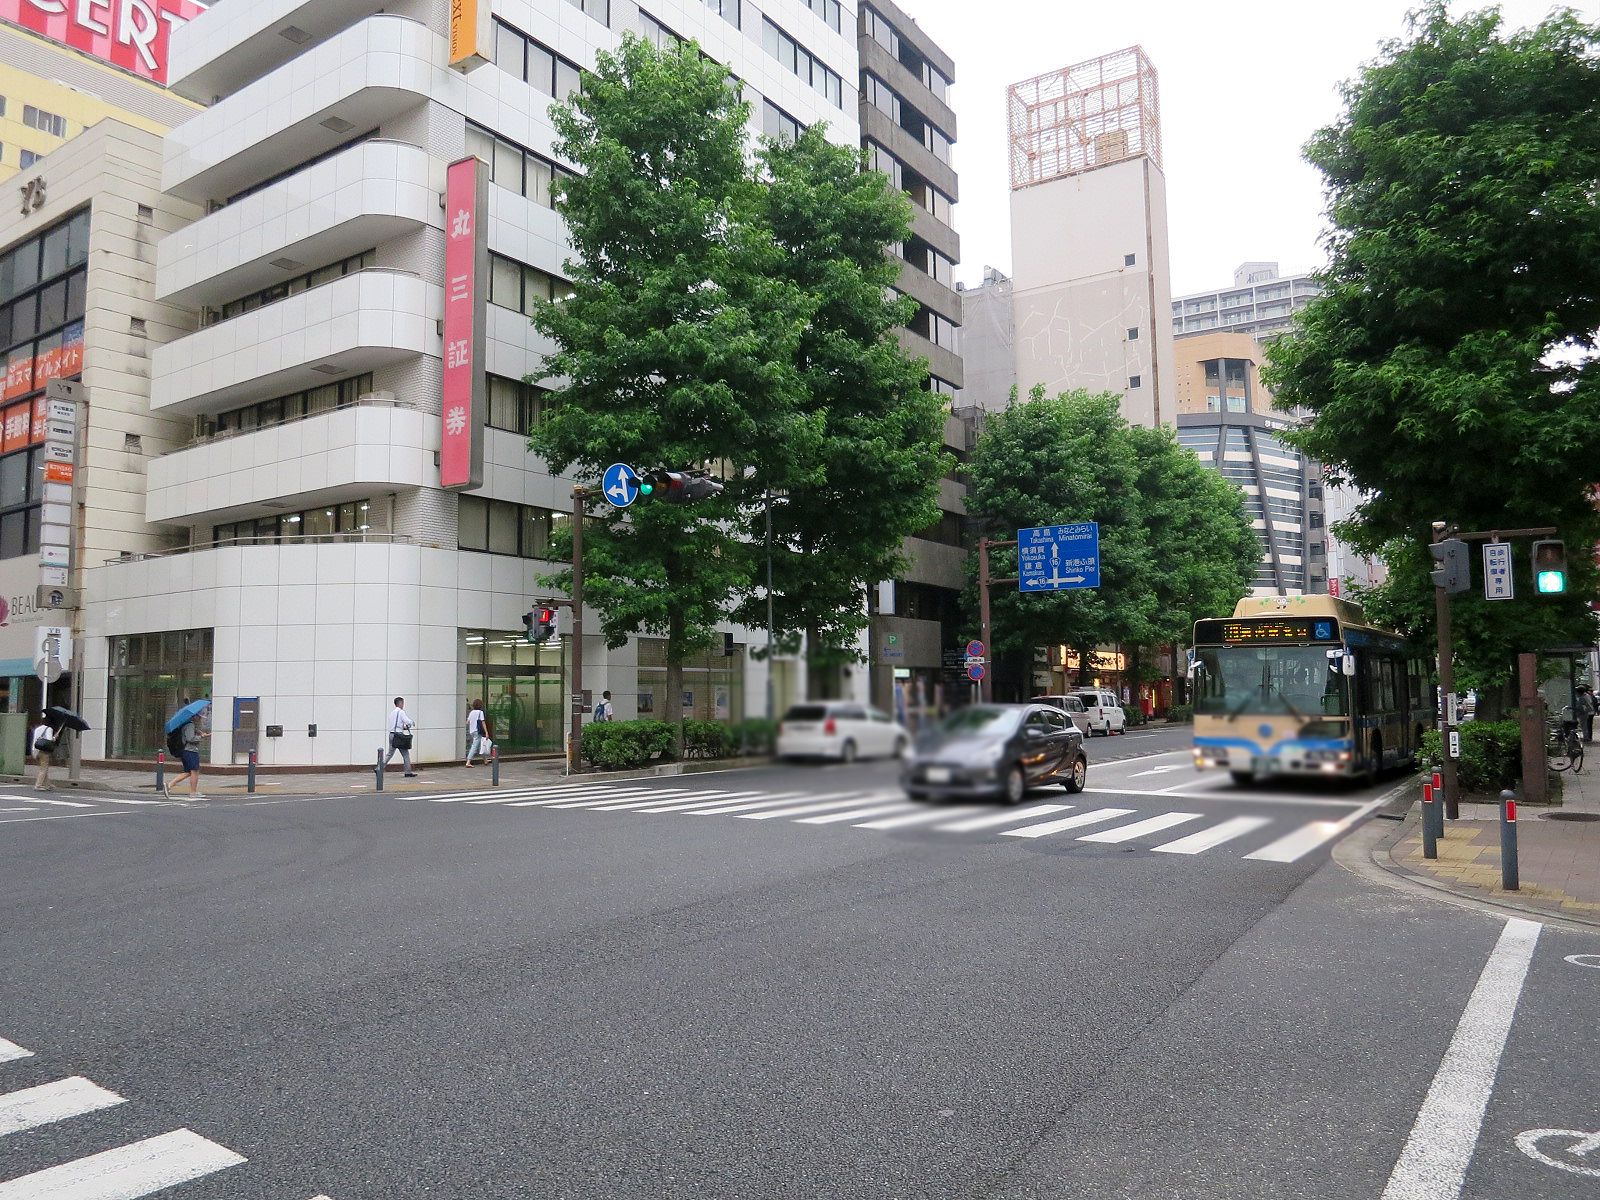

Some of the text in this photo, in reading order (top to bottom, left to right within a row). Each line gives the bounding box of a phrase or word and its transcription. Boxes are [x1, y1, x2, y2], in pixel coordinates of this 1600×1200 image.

[446, 209, 471, 436] 丸三証券
[1058, 525, 1093, 534] みなとみらい
[1058, 532, 1092, 541] Minatomirai
[1022, 546, 1045, 554] 横須賀
[1021, 553, 1046, 561] Yokosuka
[1065, 566, 1083, 574] Shinko
